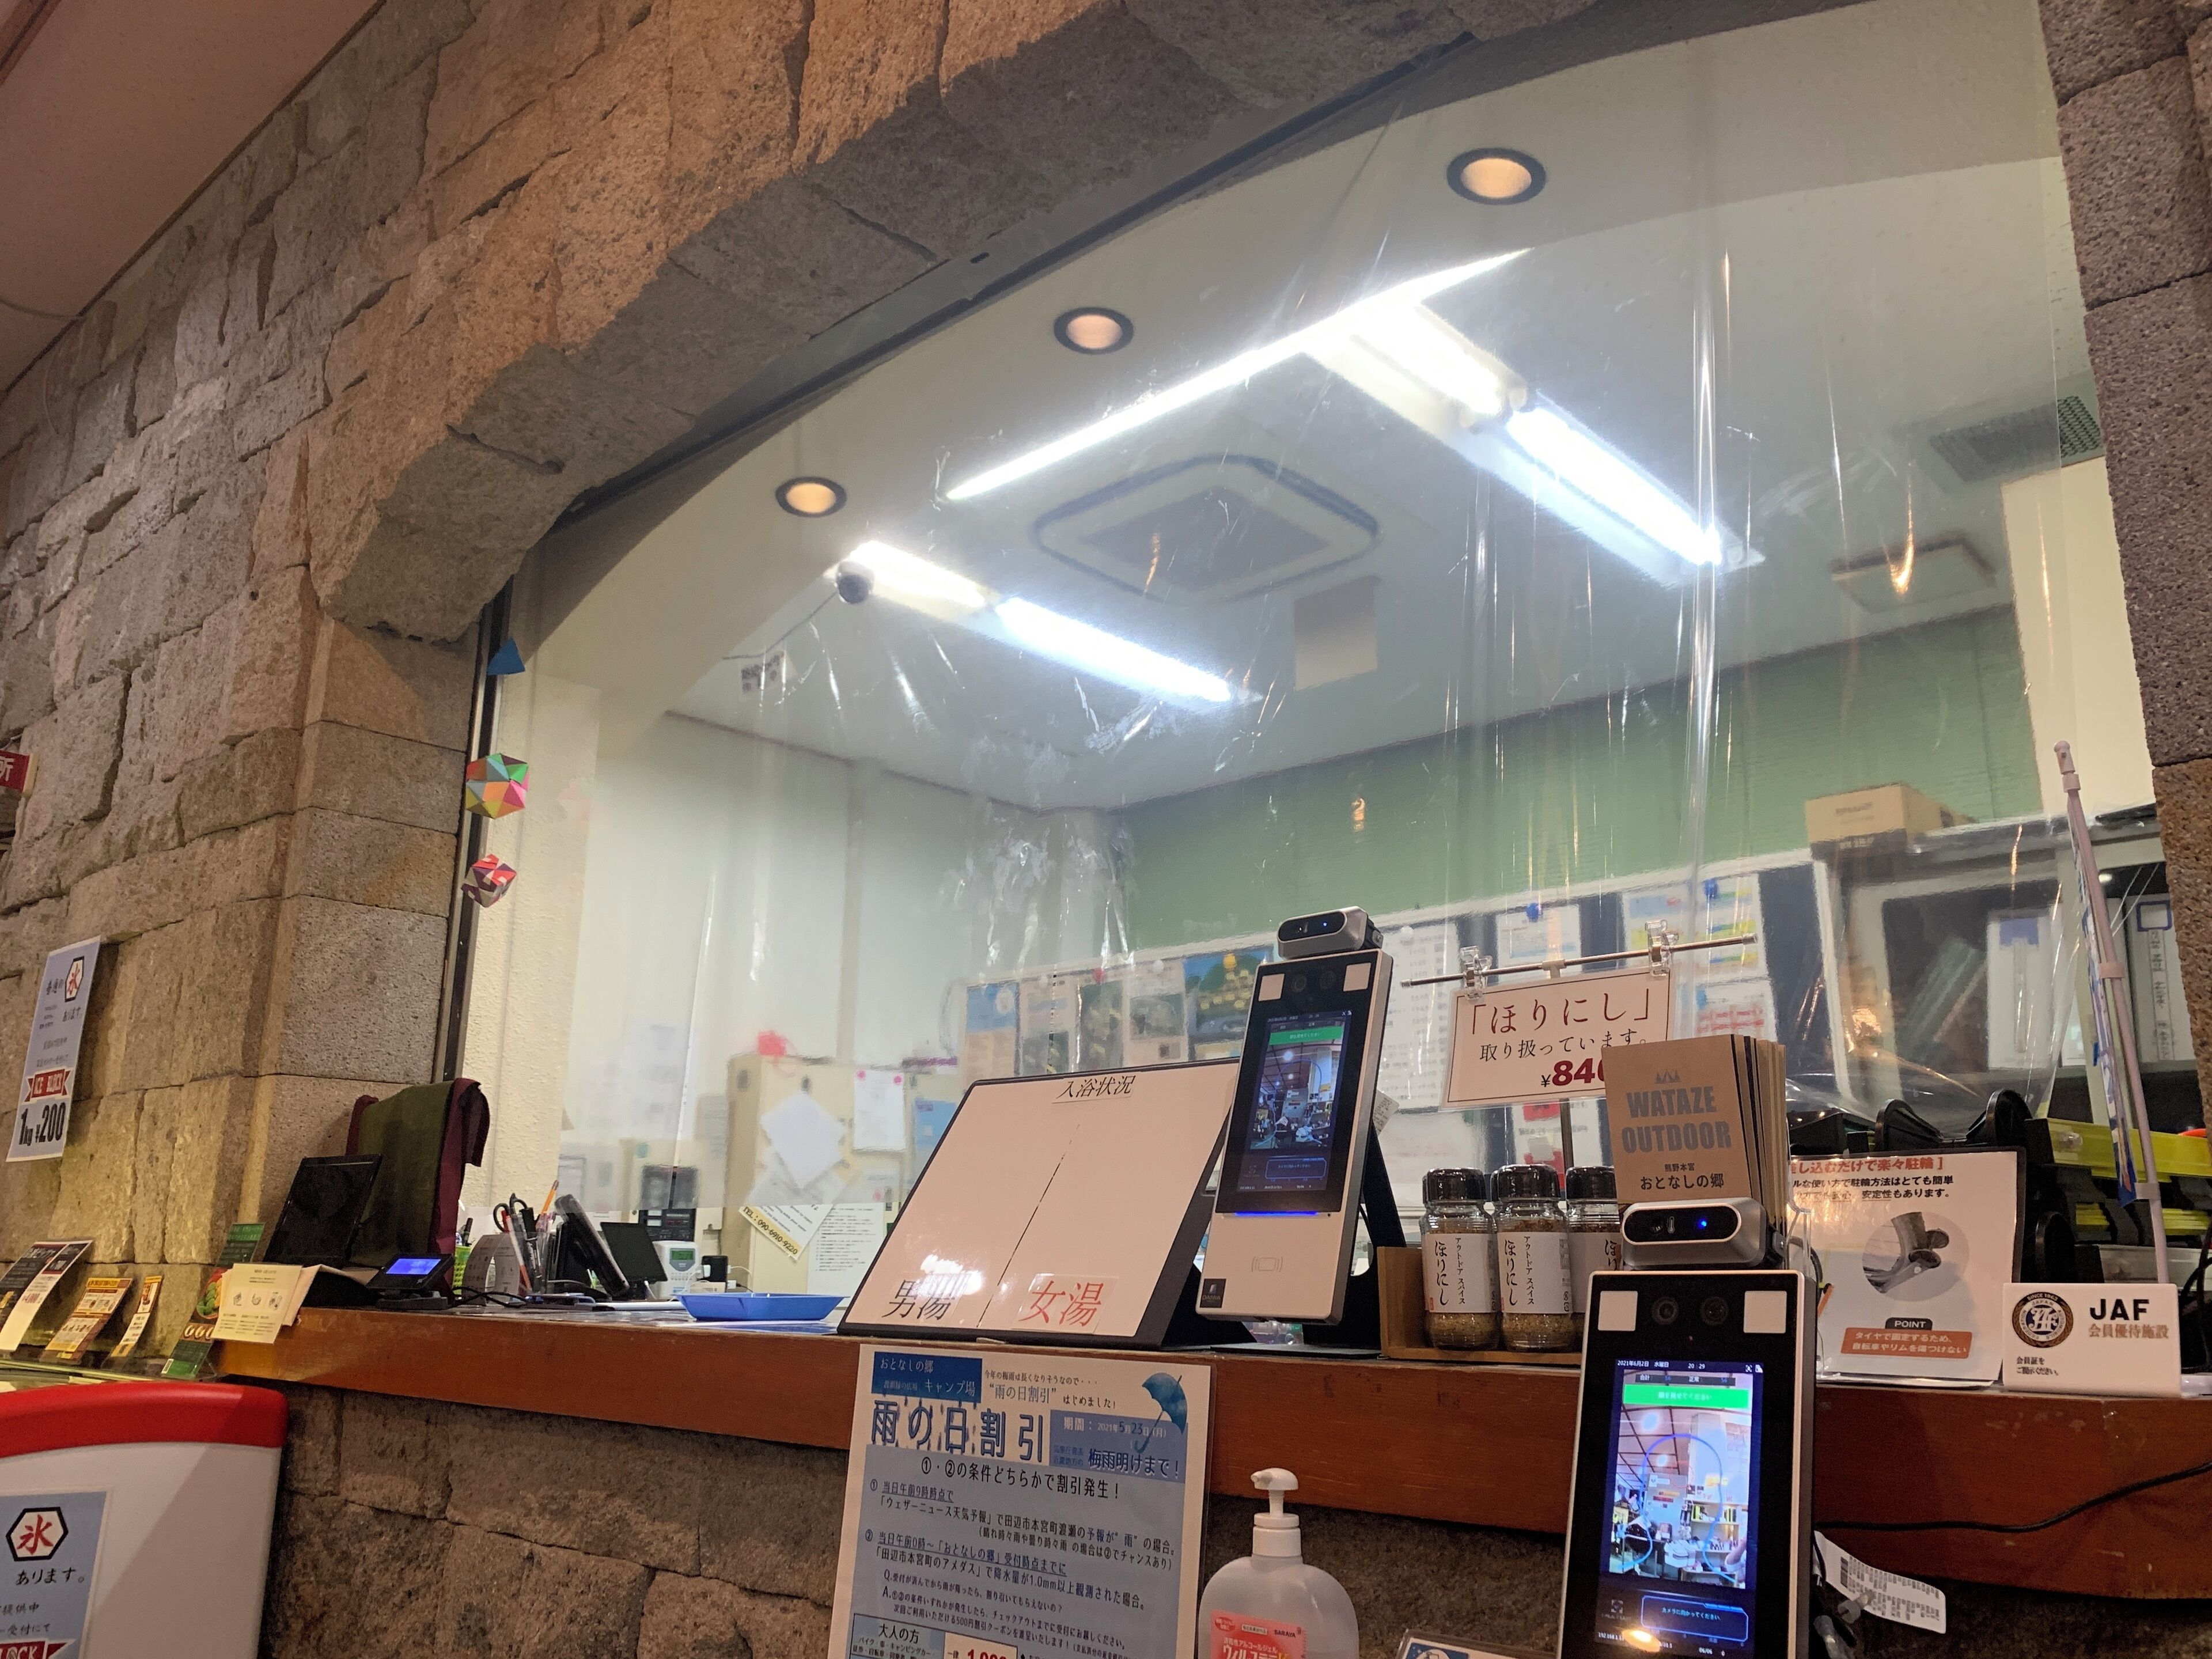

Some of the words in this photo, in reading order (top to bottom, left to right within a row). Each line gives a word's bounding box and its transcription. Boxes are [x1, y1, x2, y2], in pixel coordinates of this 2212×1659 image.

[1472, 988, 1649, 1035] 「ほりにし」
[1479, 1028, 1646, 1062] 取り扱っています。
[1056, 1075, 1136, 1099] 入浴状況
[1626, 1086, 1717, 1118] WATAZE
[35, 1102, 66, 1143] ¥200
[1622, 1121, 1732, 1153] OUTDOOR
[1664, 1162, 1695, 1172] 熊野本宮
[1641, 1173, 1724, 1190] おとなしの郷
[1455, 1237, 1464, 1275] アウトドア
[1524, 1236, 1533, 1275] アウトドア
[1435, 1240, 1449, 1306] ほりにし
[1504, 1239, 1518, 1306] ほりにし
[1018, 1280, 1104, 1327] 女湯
[1457, 1278, 1465, 1305] スパイス
[1527, 1278, 1535, 1305] スパイス
[2090, 1299, 2150, 1320] JAF
[1855, 1332, 1952, 1343] タイヤで固定するため、
[2088, 1324, 2169, 1339] 会員優待施設
[880, 1358, 934, 1373] おとなしの郷
[2017, 1357, 2044, 1365] 会員証を
[925, 1378, 975, 1397] キャンプ場
[872, 1400, 1043, 1463] 雨の日割引
[17, 1514, 55, 1555] 氷
[16, 1567, 85, 1585] あります。
[0, 1601, 40, 1616] 提供中
[878, 1623, 919, 1644] 大人の方
[1274, 1629, 1296, 1638] SARAYA
